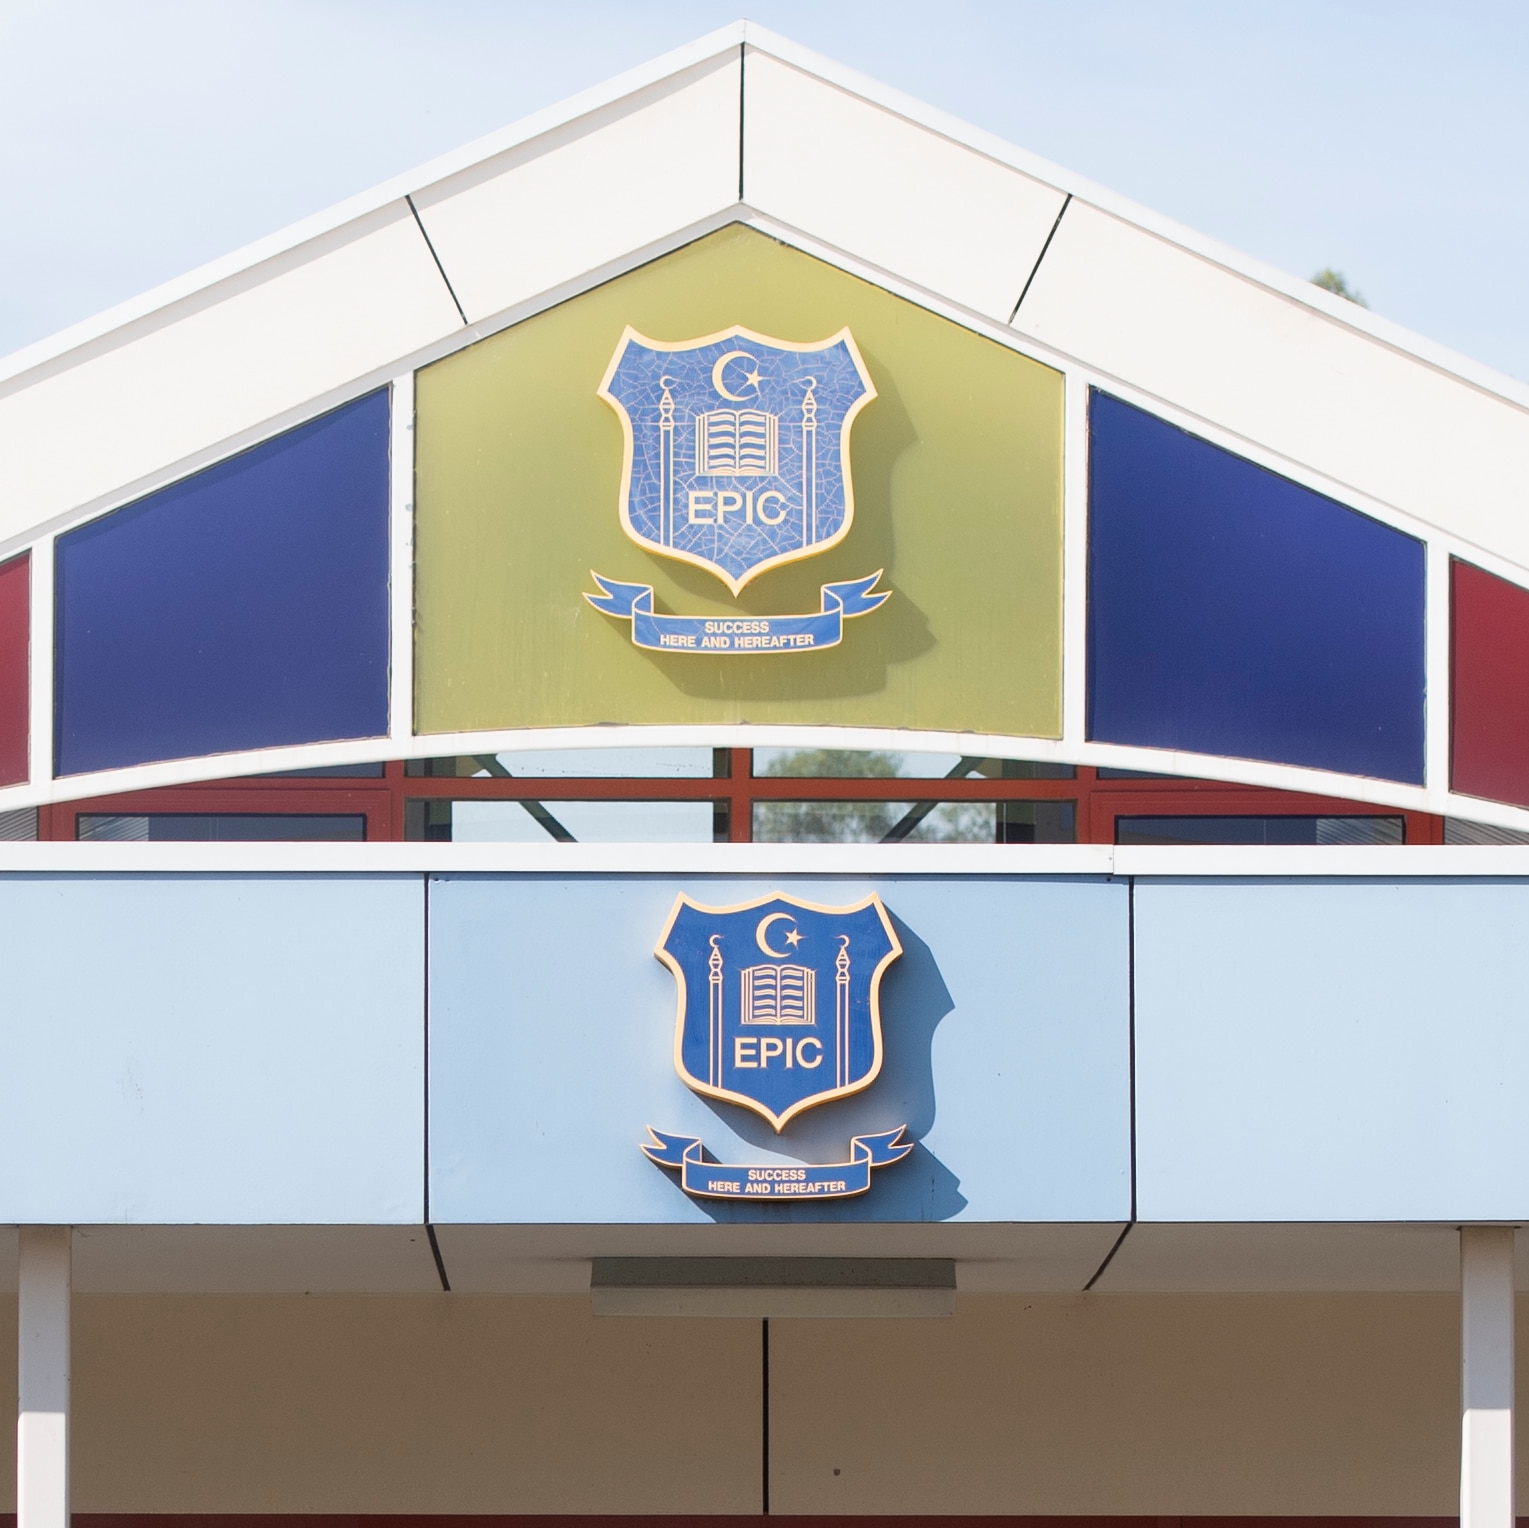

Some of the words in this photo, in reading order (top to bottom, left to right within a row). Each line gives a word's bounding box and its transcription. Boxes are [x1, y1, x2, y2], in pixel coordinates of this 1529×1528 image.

[688, 490, 788, 525] EPIC
[705, 621, 770, 633] SUCCESS
[660, 634, 696, 647] HERE
[701, 636, 730, 648] AND
[734, 634, 815, 648] HEREAFTER
[733, 1036, 823, 1069] EPIC
[748, 1169, 806, 1181] SUCCESS
[708, 1181, 740, 1192] HERE
[745, 1182, 771, 1194] AND
[774, 1181, 846, 1194] HEREAFTER
